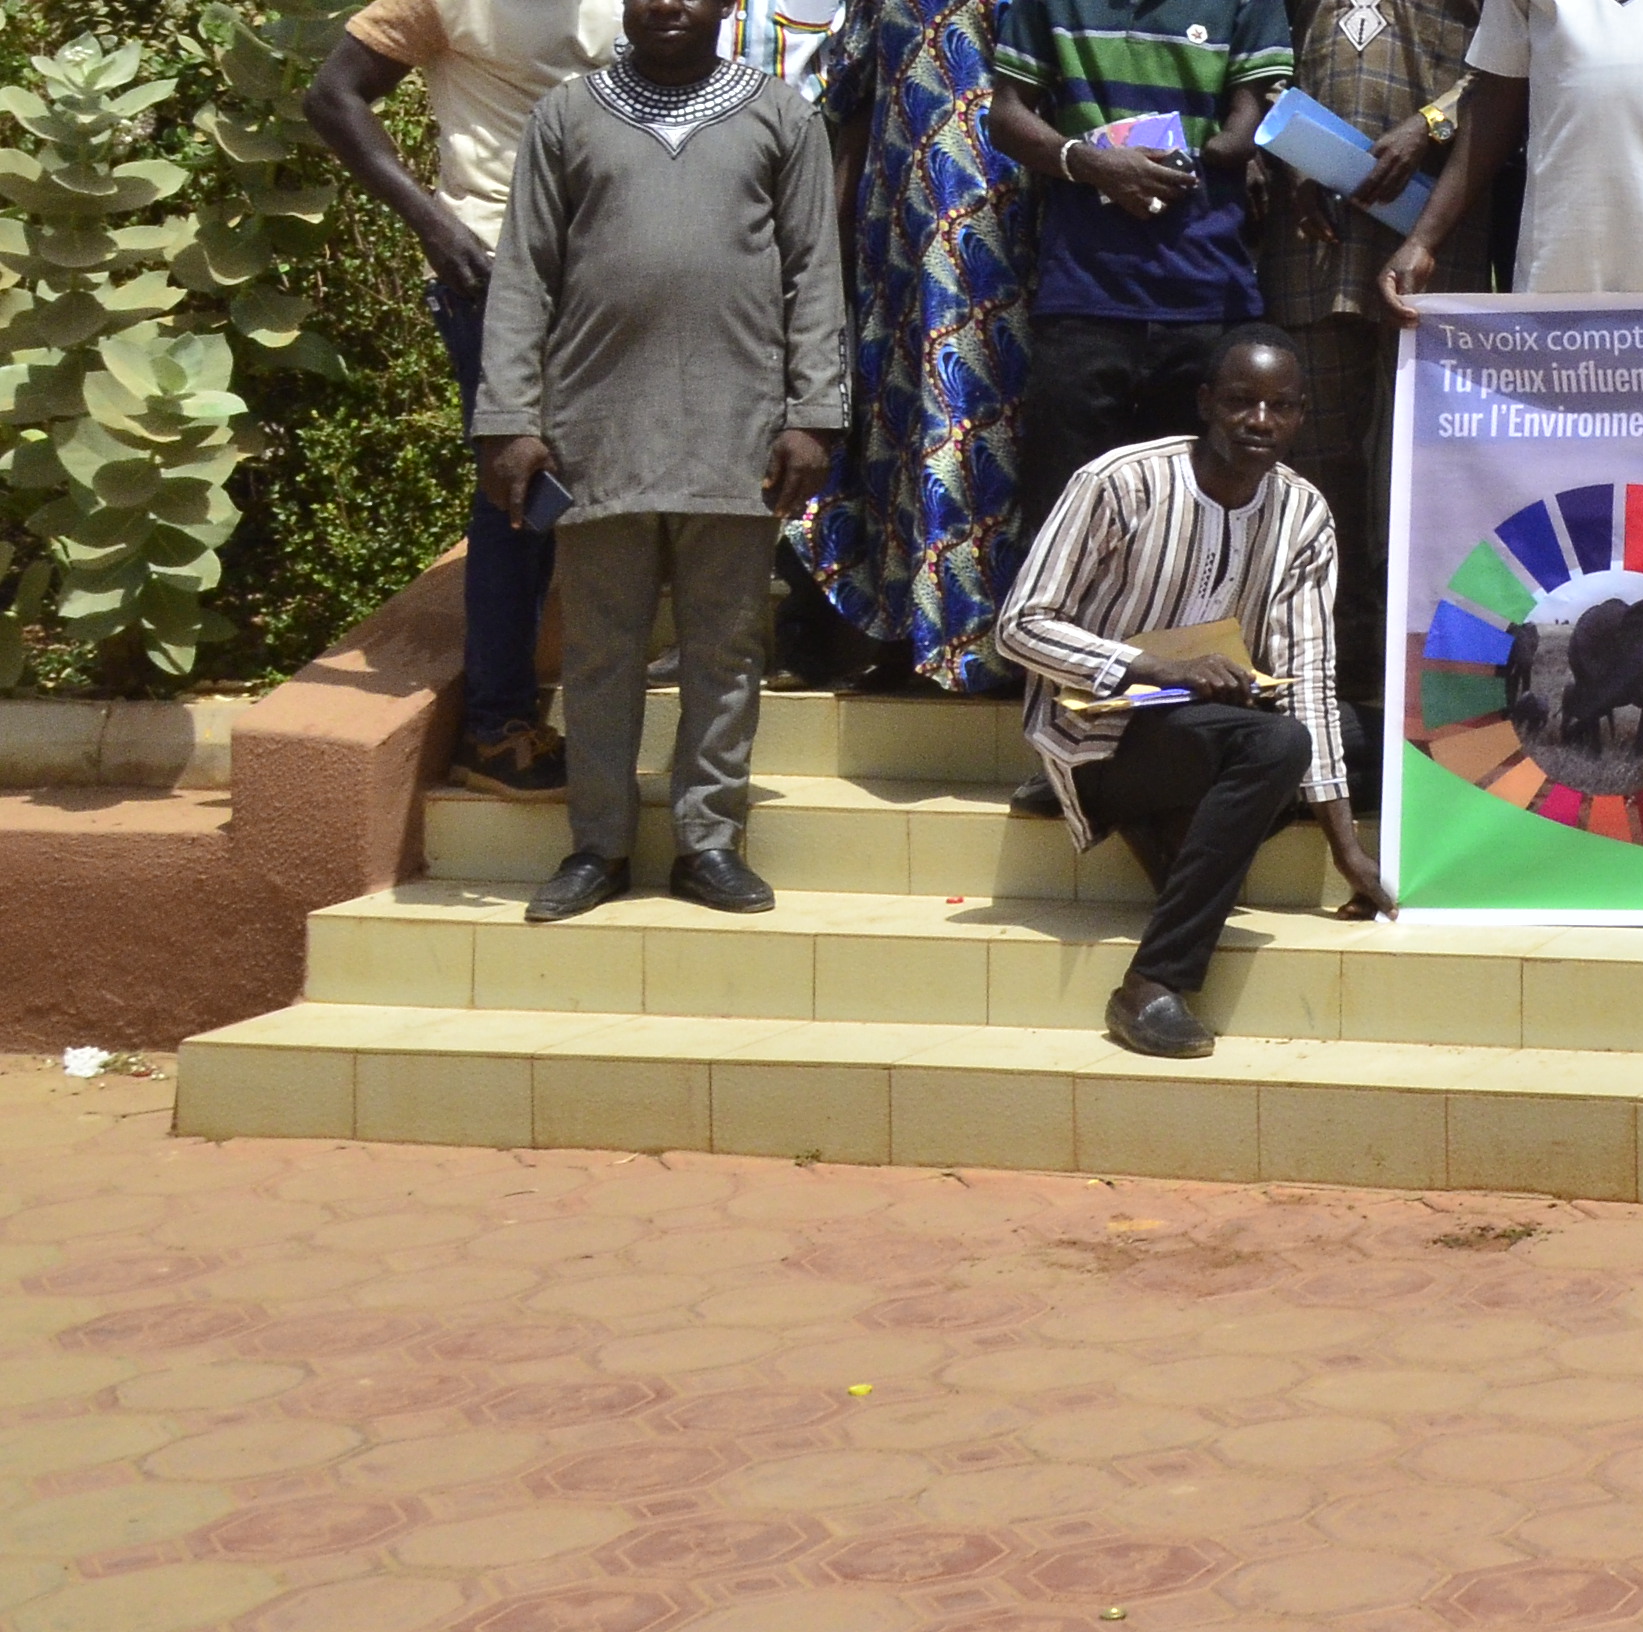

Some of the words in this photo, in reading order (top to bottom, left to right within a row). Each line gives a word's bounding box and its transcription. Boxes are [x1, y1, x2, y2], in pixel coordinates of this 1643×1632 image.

[1439, 325, 1473, 349] Ta
[1478, 327, 1539, 351] voix
[1439, 359, 1472, 392] Tu
[1480, 368, 1547, 399] peux
[1439, 410, 1483, 437] sur
